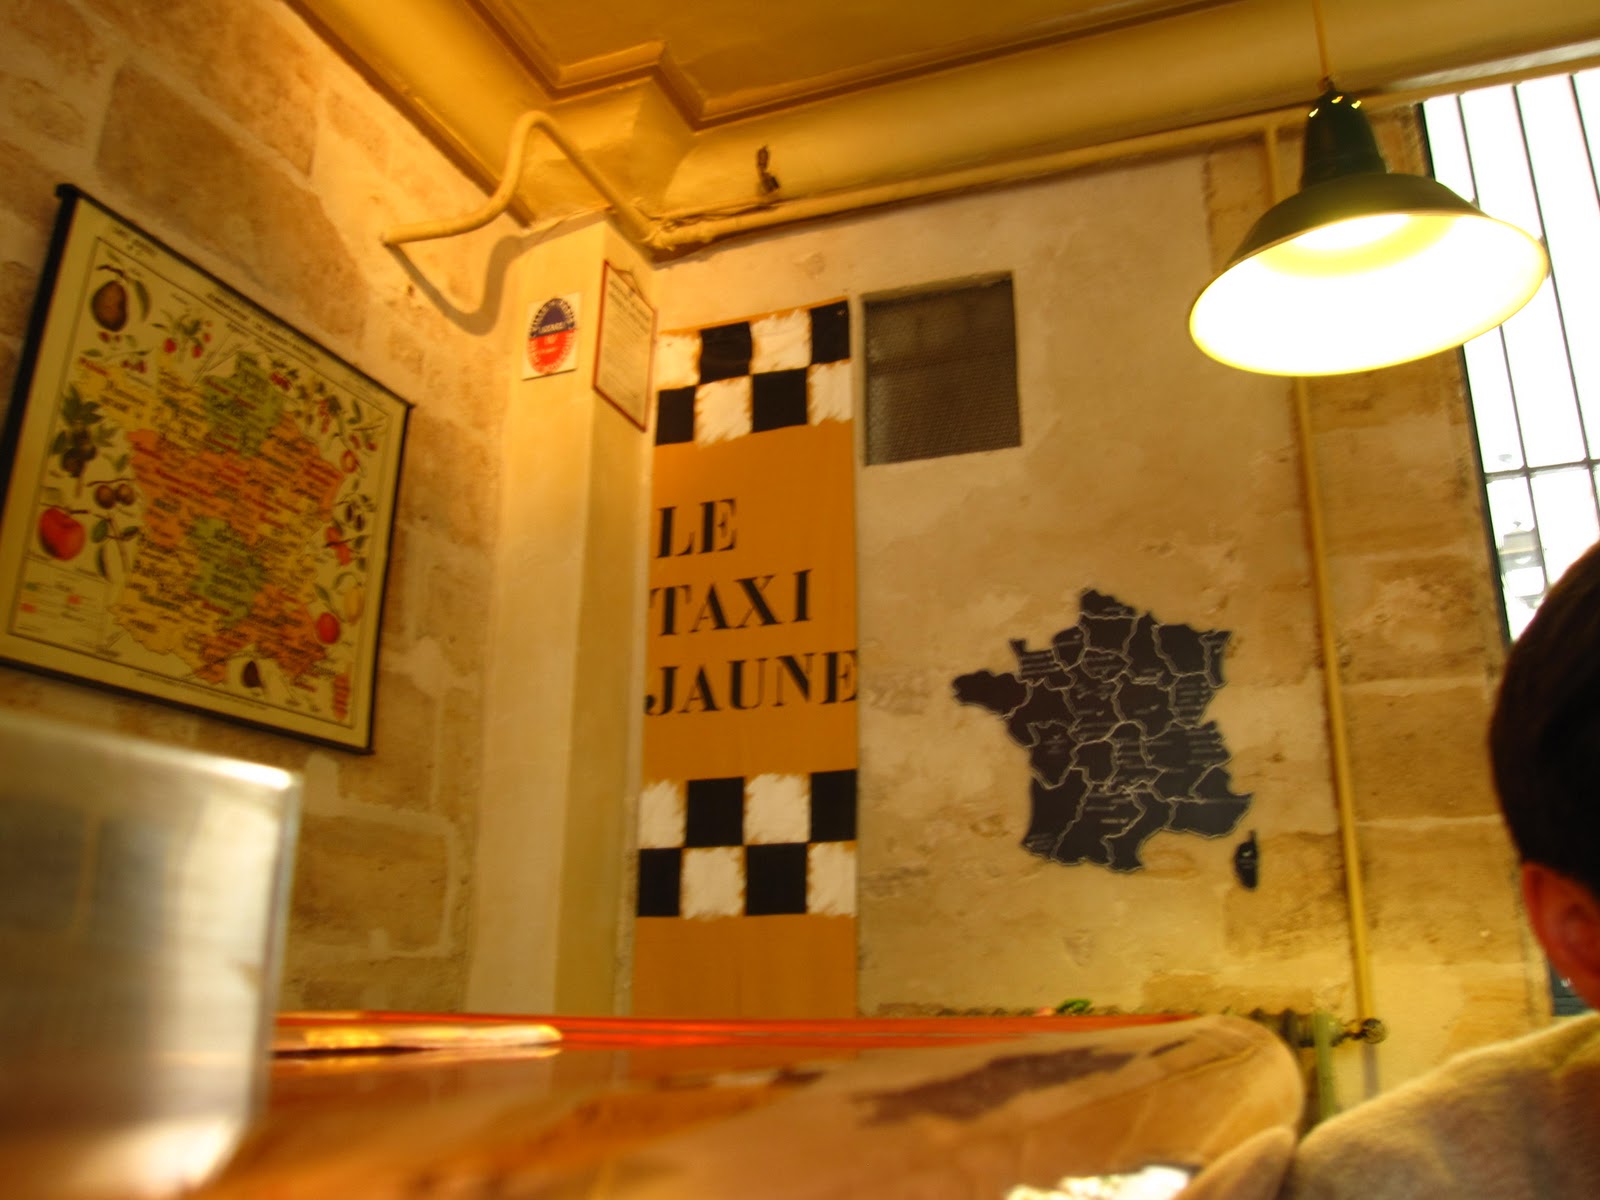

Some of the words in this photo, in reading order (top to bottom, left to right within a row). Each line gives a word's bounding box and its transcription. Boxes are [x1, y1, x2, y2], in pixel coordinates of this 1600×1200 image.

[656, 498, 737, 559] LE
[650, 568, 813, 636] TAXI
[644, 650, 859, 716] JAUNE
